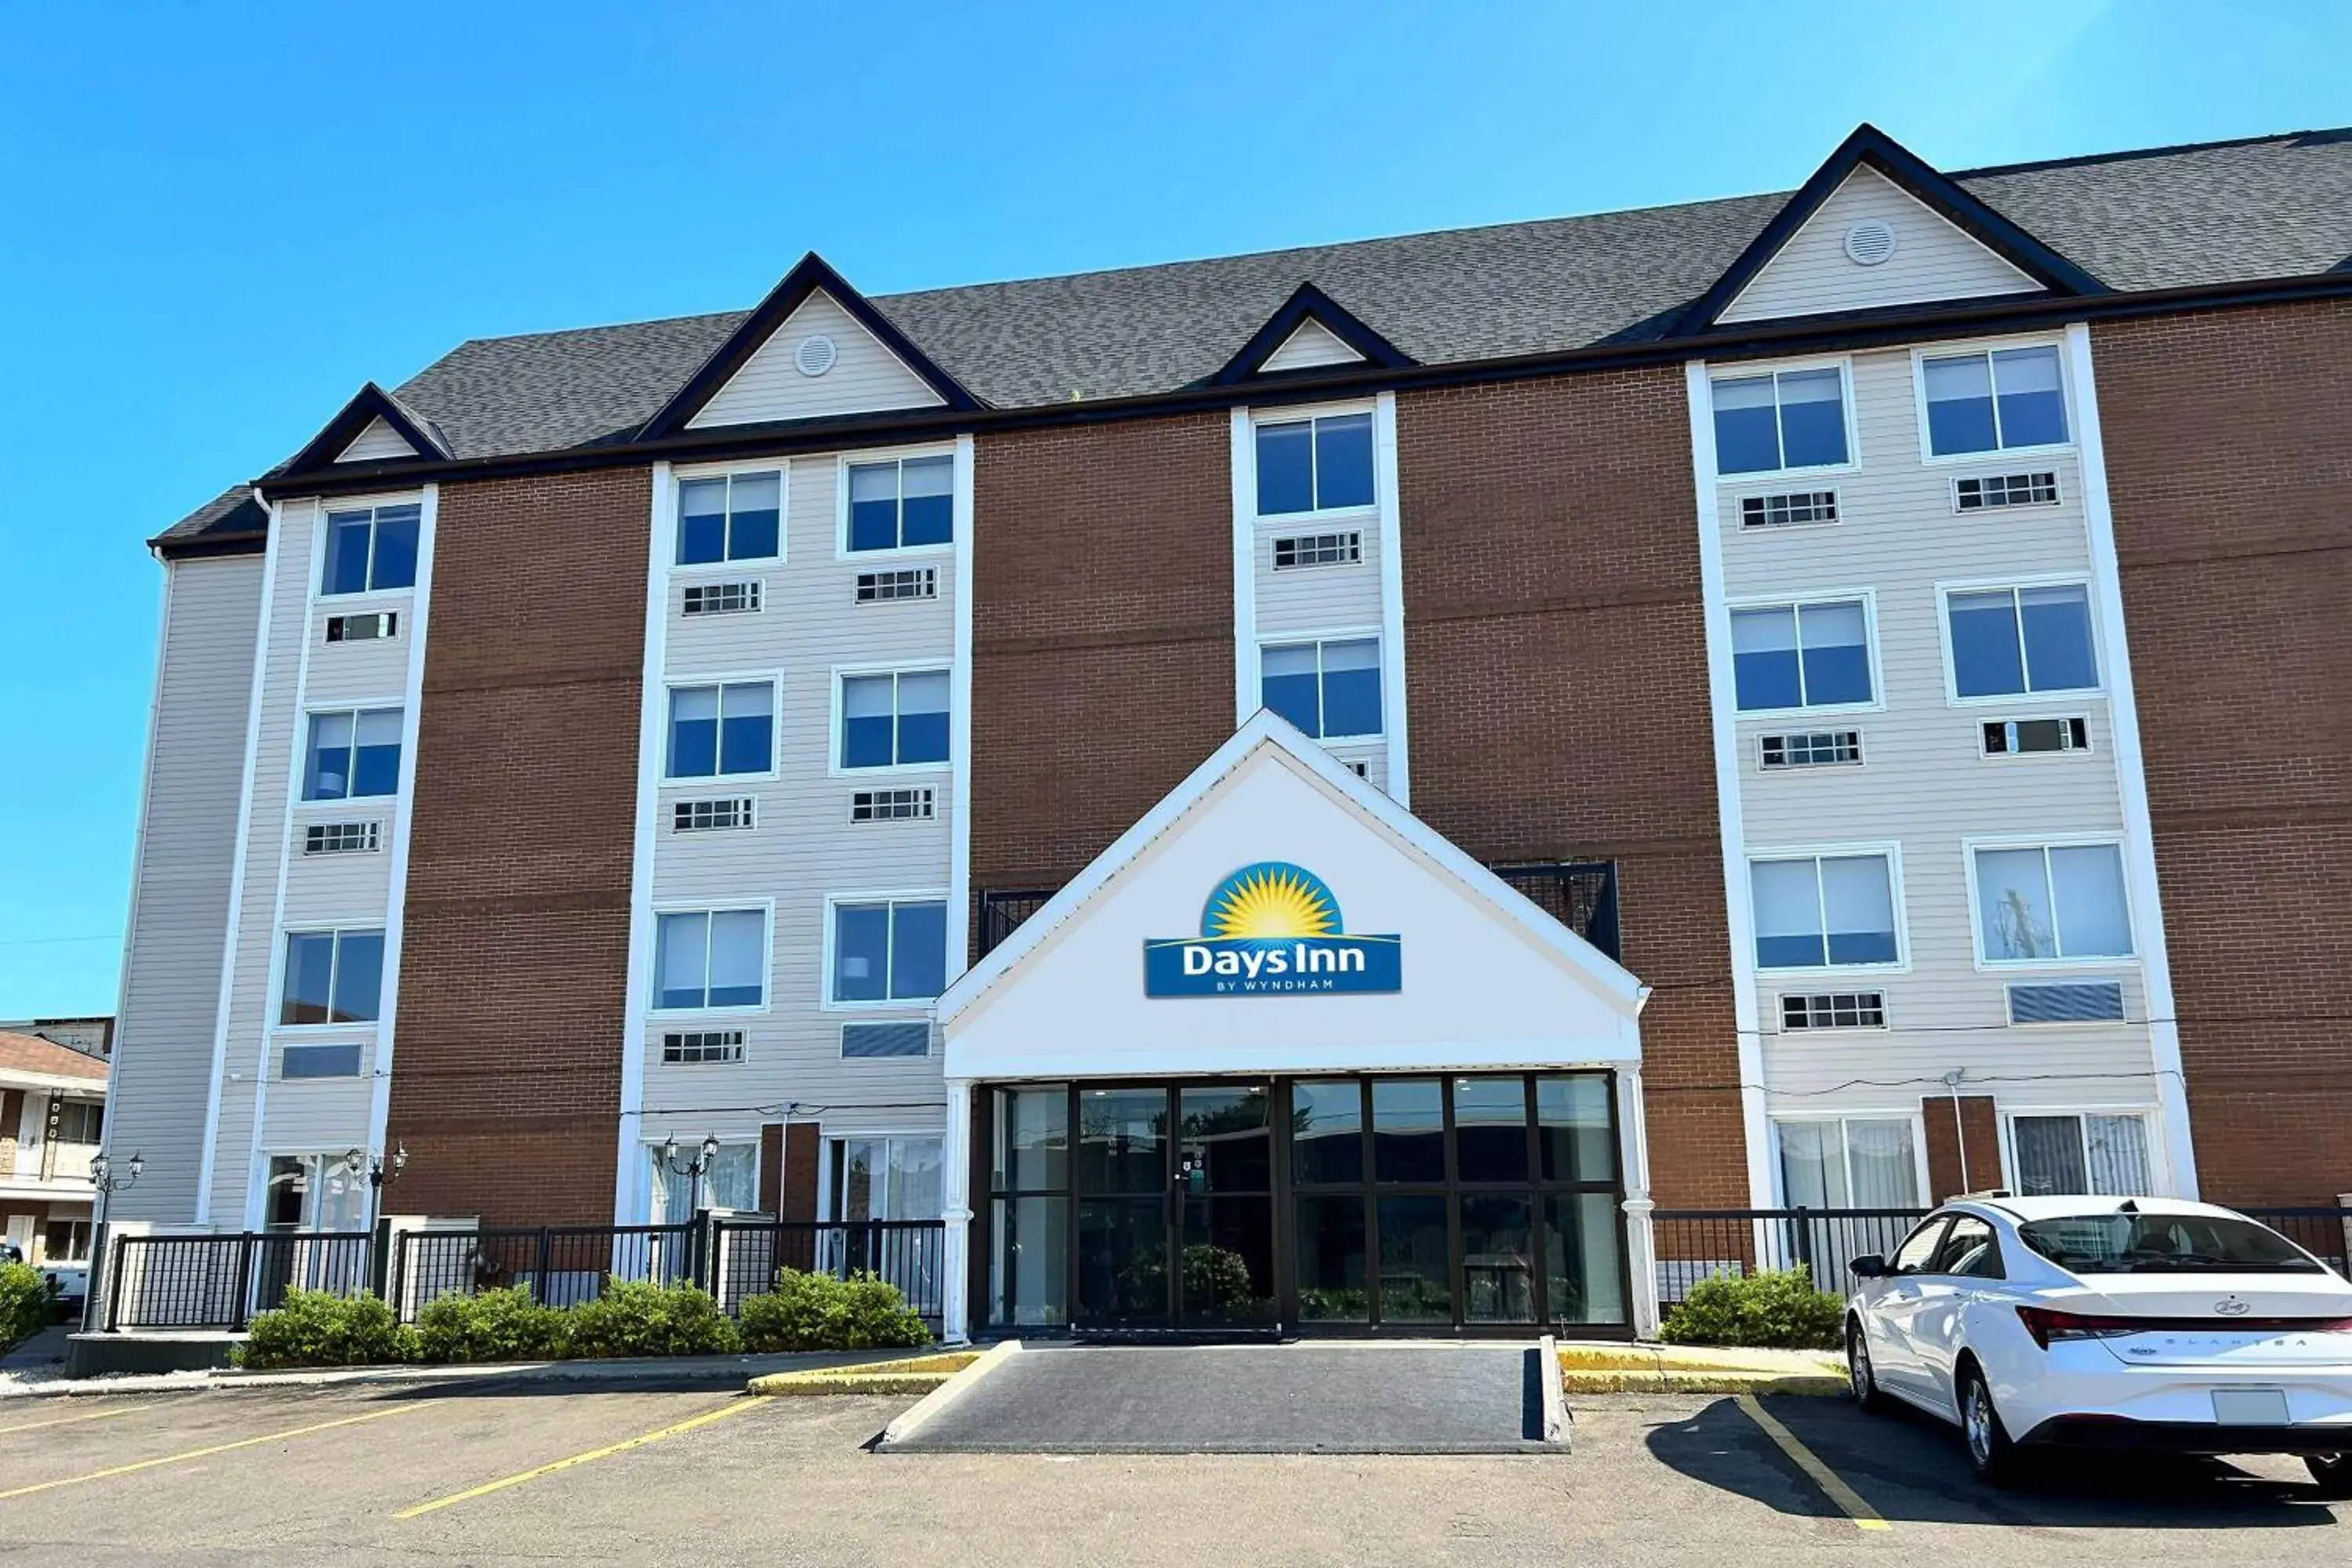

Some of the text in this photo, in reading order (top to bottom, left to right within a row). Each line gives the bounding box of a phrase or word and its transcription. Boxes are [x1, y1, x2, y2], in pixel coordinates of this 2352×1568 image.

[1182, 943, 1366, 979] Days Inn
[1216, 979, 1333, 992] BY WYNDHAM
